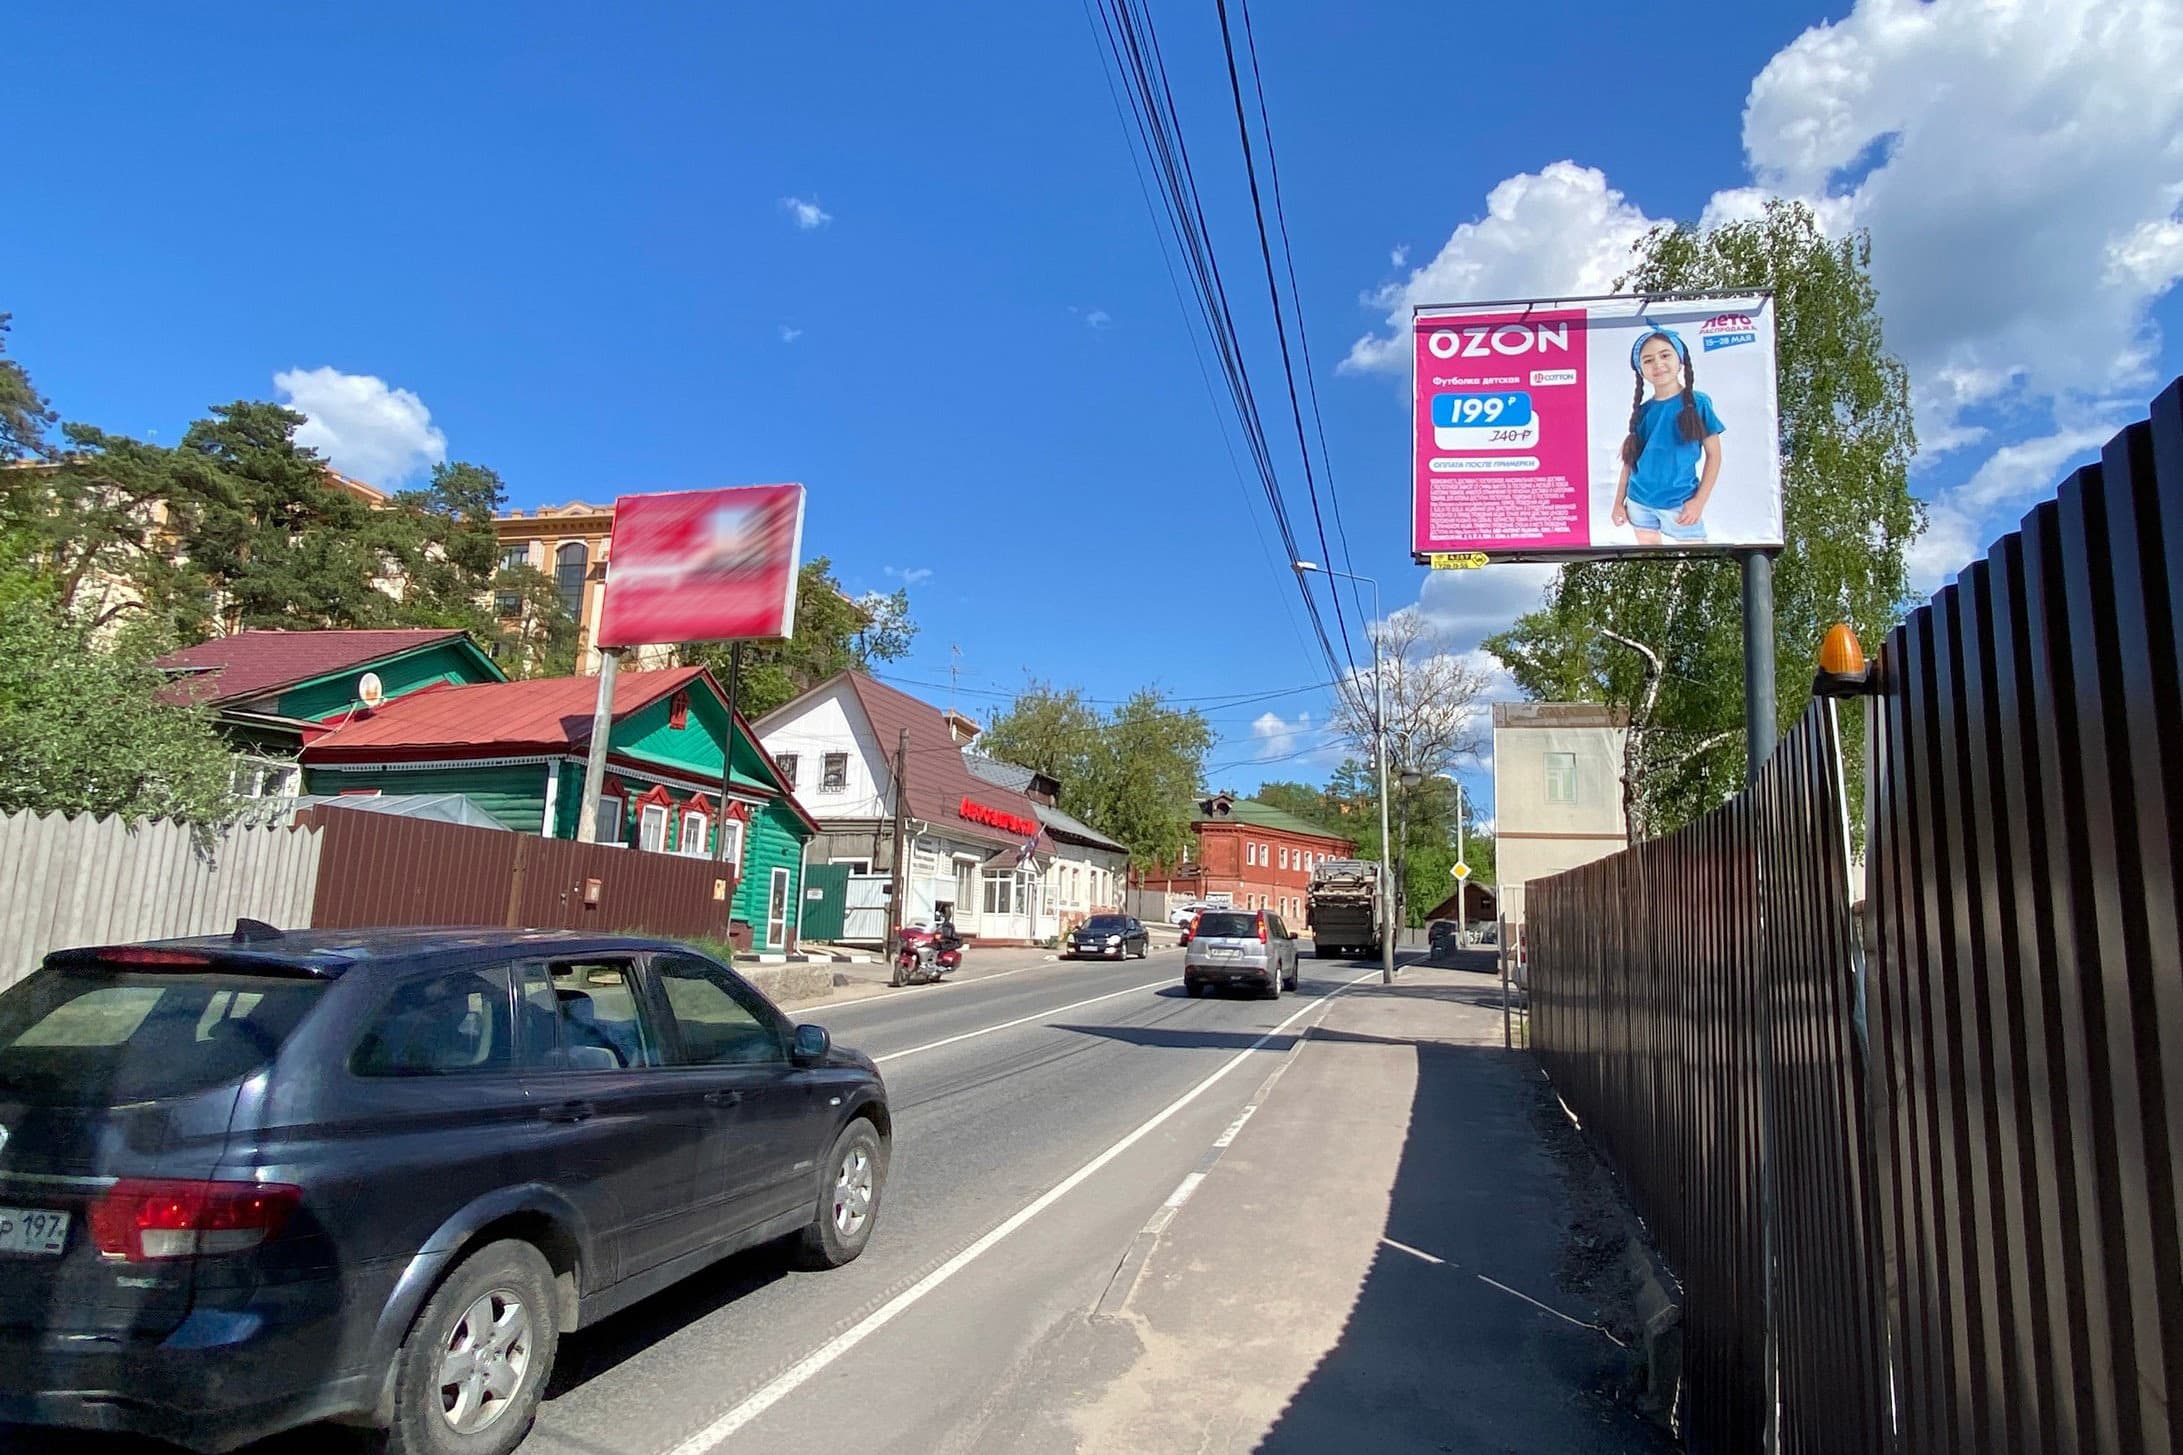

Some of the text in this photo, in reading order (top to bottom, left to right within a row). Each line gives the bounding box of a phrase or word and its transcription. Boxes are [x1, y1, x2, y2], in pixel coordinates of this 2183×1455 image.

[1428, 322, 1569, 359] OZON
[1731, 334, 1752, 344] МАЯ
[1433, 375, 1520, 387] Футболка детская
[1544, 373, 1574, 382] COTTON
[1433, 460, 1535, 469] ОПЛАТА ПОСЛЕ ПРИМЕРКИ
[22, 1213, 61, 1238] 197
